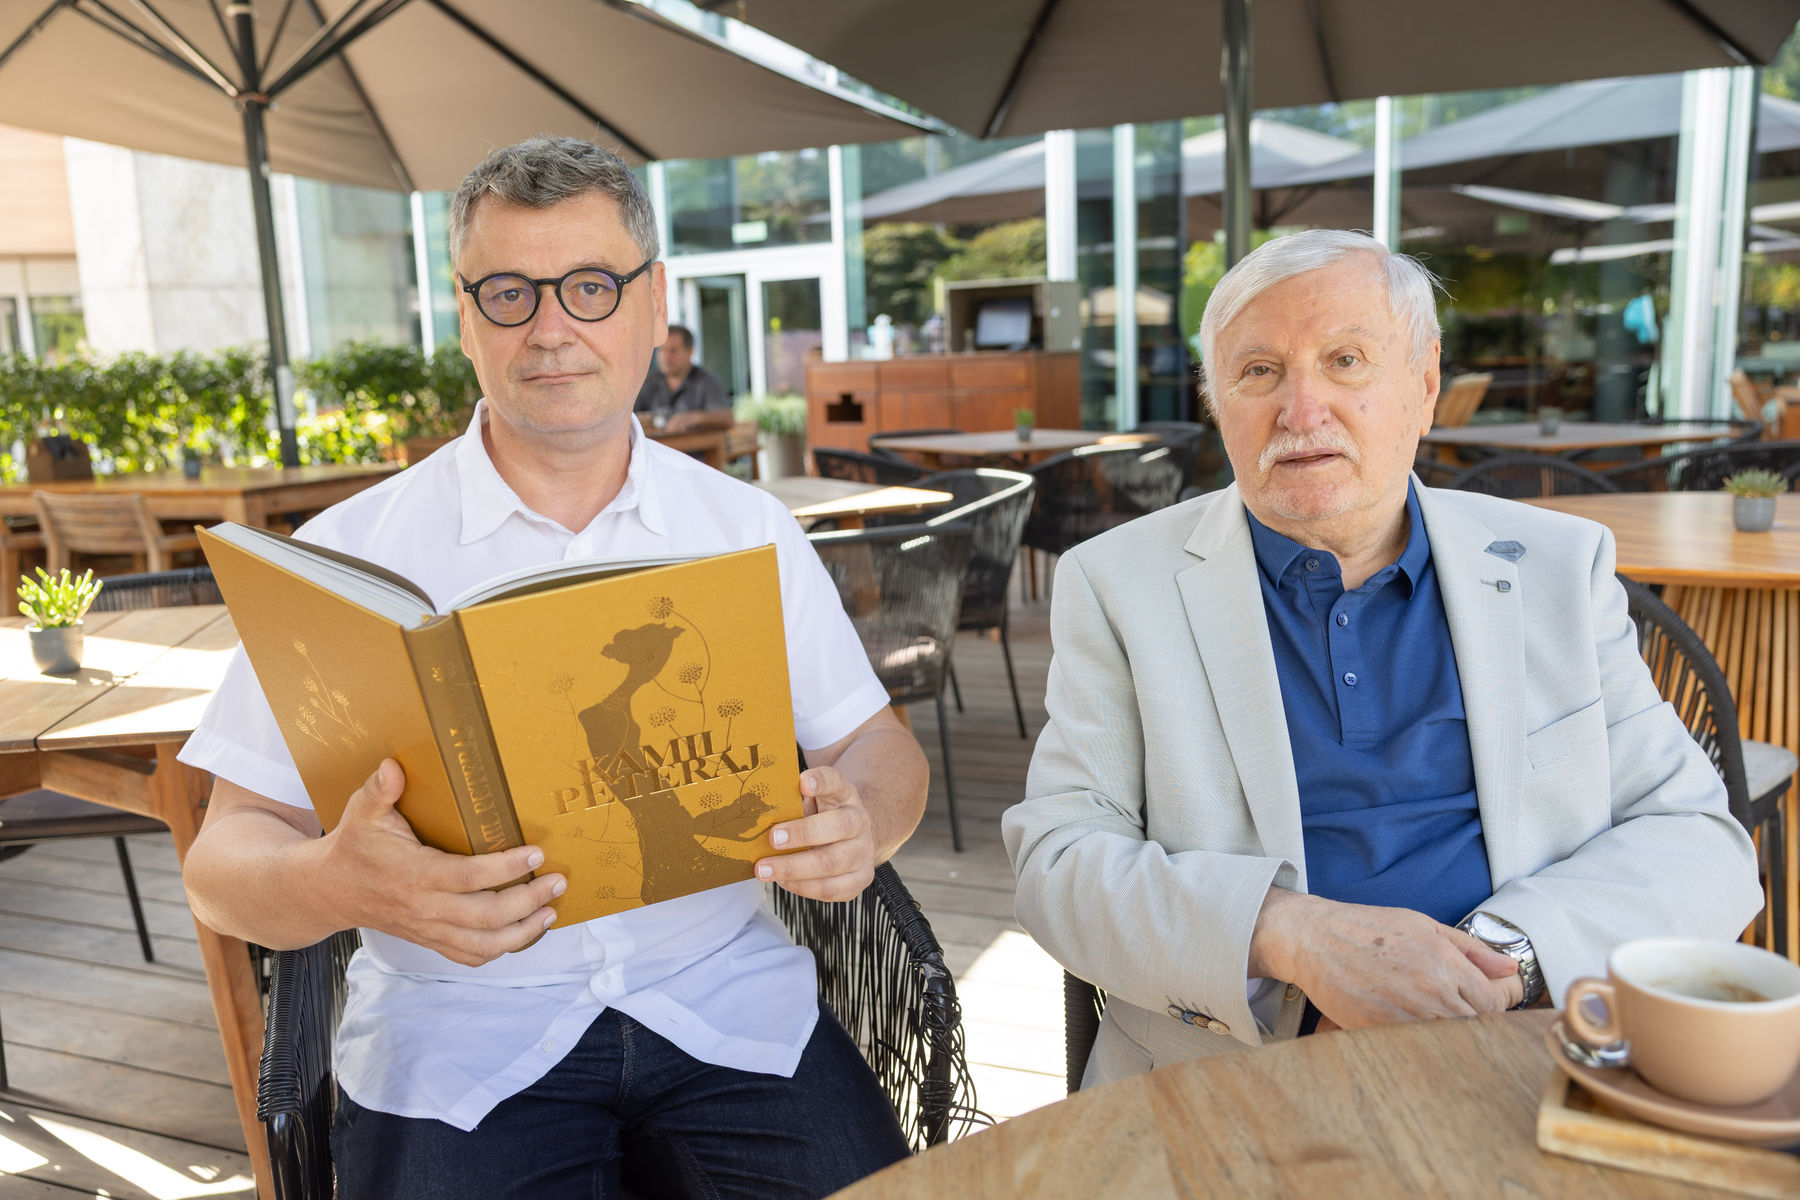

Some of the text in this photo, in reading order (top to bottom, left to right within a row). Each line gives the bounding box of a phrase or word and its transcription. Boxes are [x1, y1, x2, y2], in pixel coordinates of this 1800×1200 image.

[549, 743, 762, 817] PETERAJ
[576, 730, 732, 786] KAMIL
[481, 815, 506, 852] MIL
